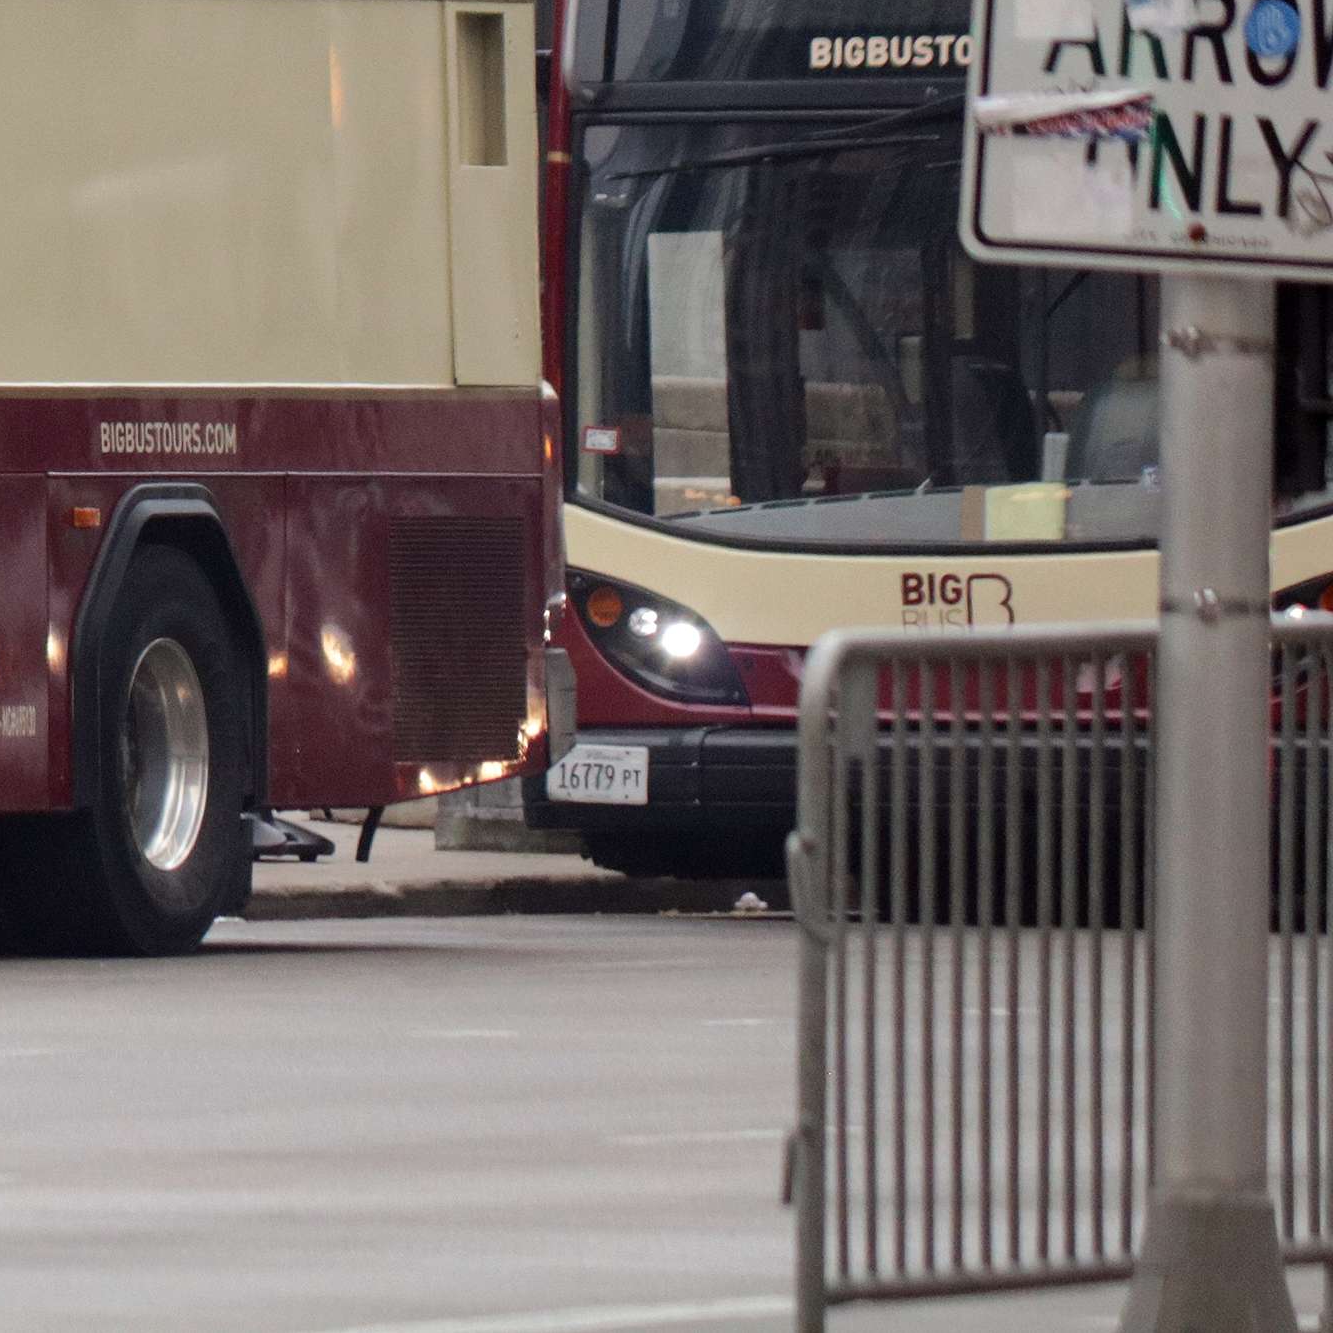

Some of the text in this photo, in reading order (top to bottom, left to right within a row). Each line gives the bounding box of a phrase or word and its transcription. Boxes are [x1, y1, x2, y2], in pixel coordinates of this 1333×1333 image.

[1087, 110, 1319, 220] NLY
[100, 421, 237, 455] BIGBUSTOURS.COM
[902, 573, 963, 605] BIG
[557, 761, 642, 790] 16779 PT
